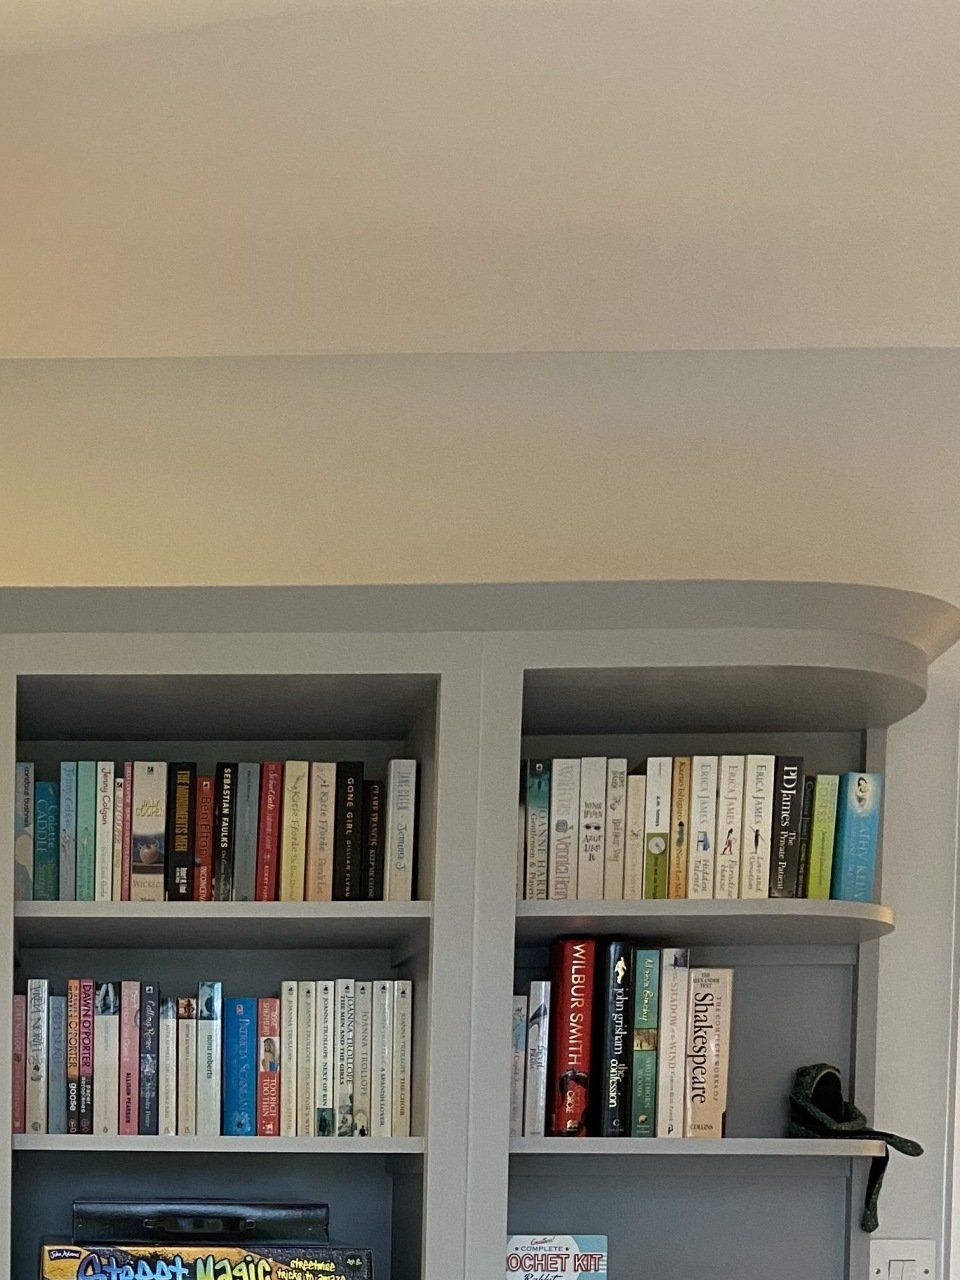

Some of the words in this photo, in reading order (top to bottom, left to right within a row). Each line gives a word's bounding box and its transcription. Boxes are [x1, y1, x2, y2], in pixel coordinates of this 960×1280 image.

[221, 768, 232, 816] SEBASTIAN
[699, 764, 712, 793] ERICA
[727, 765, 738, 794] ERICA
[755, 764, 767, 793] ERICA
[783, 765, 799, 788] PD
[697, 795, 711, 825] JAMES
[724, 796, 738, 825] JAMES
[752, 795, 766, 825] JAMES
[780, 789, 798, 827] James
[220, 818, 230, 850] FAULKS
[778, 831, 789, 859] Private
[788, 830, 797, 846] The
[776, 861, 788, 890] Patient
[570, 944, 587, 1009] WILBUR
[82, 984, 92, 1018] DAWN
[345, 995, 354, 1033] JOANNA
[614, 988, 630, 1011] john
[669, 982, 679, 1027] SHADOW
[82, 1019, 92, 1068] O'PORTER
[360, 1011, 369, 1047] JOANNA
[567, 1012, 585, 1066] SMITH
[610, 1013, 628, 1056] grisham
[345, 1036, 354, 1085] TROLLOPE
[668, 1041, 678, 1069] WIND
[687, 992, 715, 1105] Shakespeare
[360, 1051, 368, 1097] TROLLOPE
[608, 1058, 623, 1108] confession
